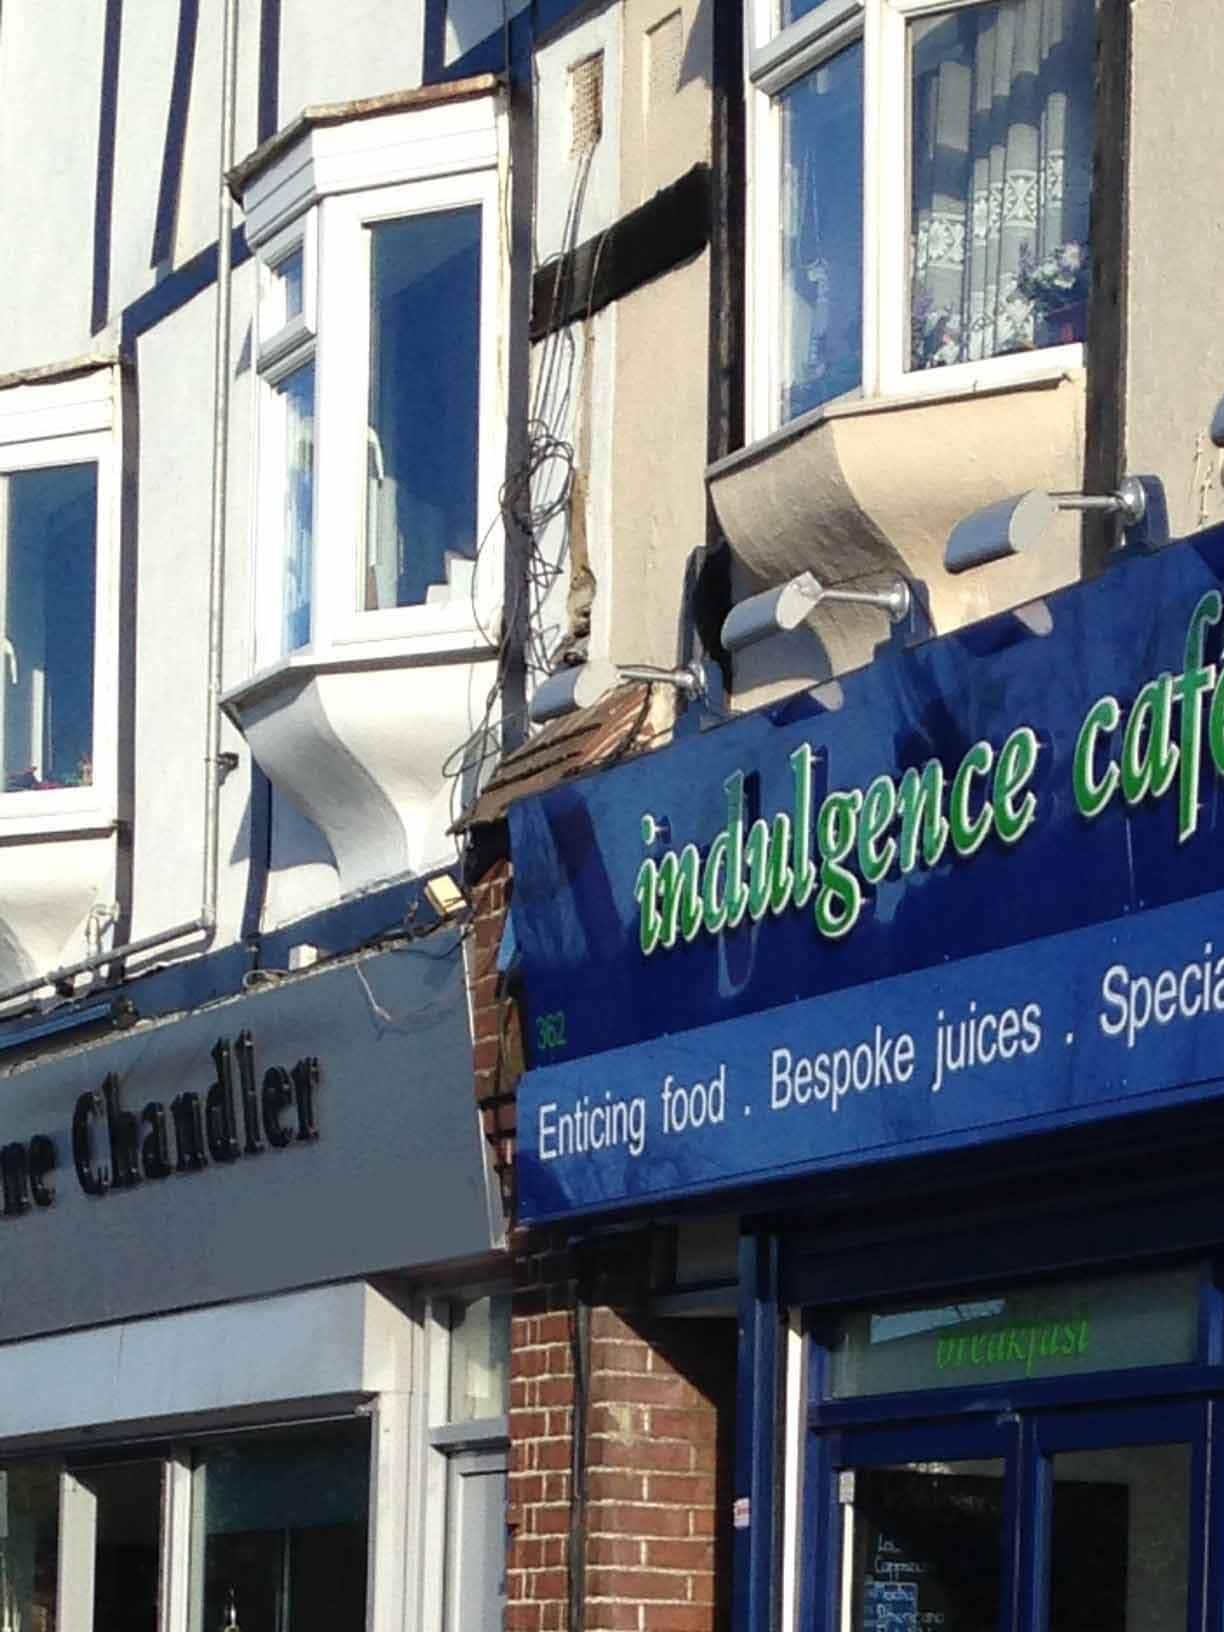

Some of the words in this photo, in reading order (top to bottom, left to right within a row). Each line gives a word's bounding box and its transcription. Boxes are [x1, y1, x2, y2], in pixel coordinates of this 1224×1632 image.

[635, 726, 1038, 955] indulgence
[72, 1029, 320, 1196] Chandler
[538, 1094, 646, 1160] Enticing
[662, 1064, 727, 1134] food
[771, 1025, 915, 1112] Bespoke
[932, 1001, 1041, 1092] juices
